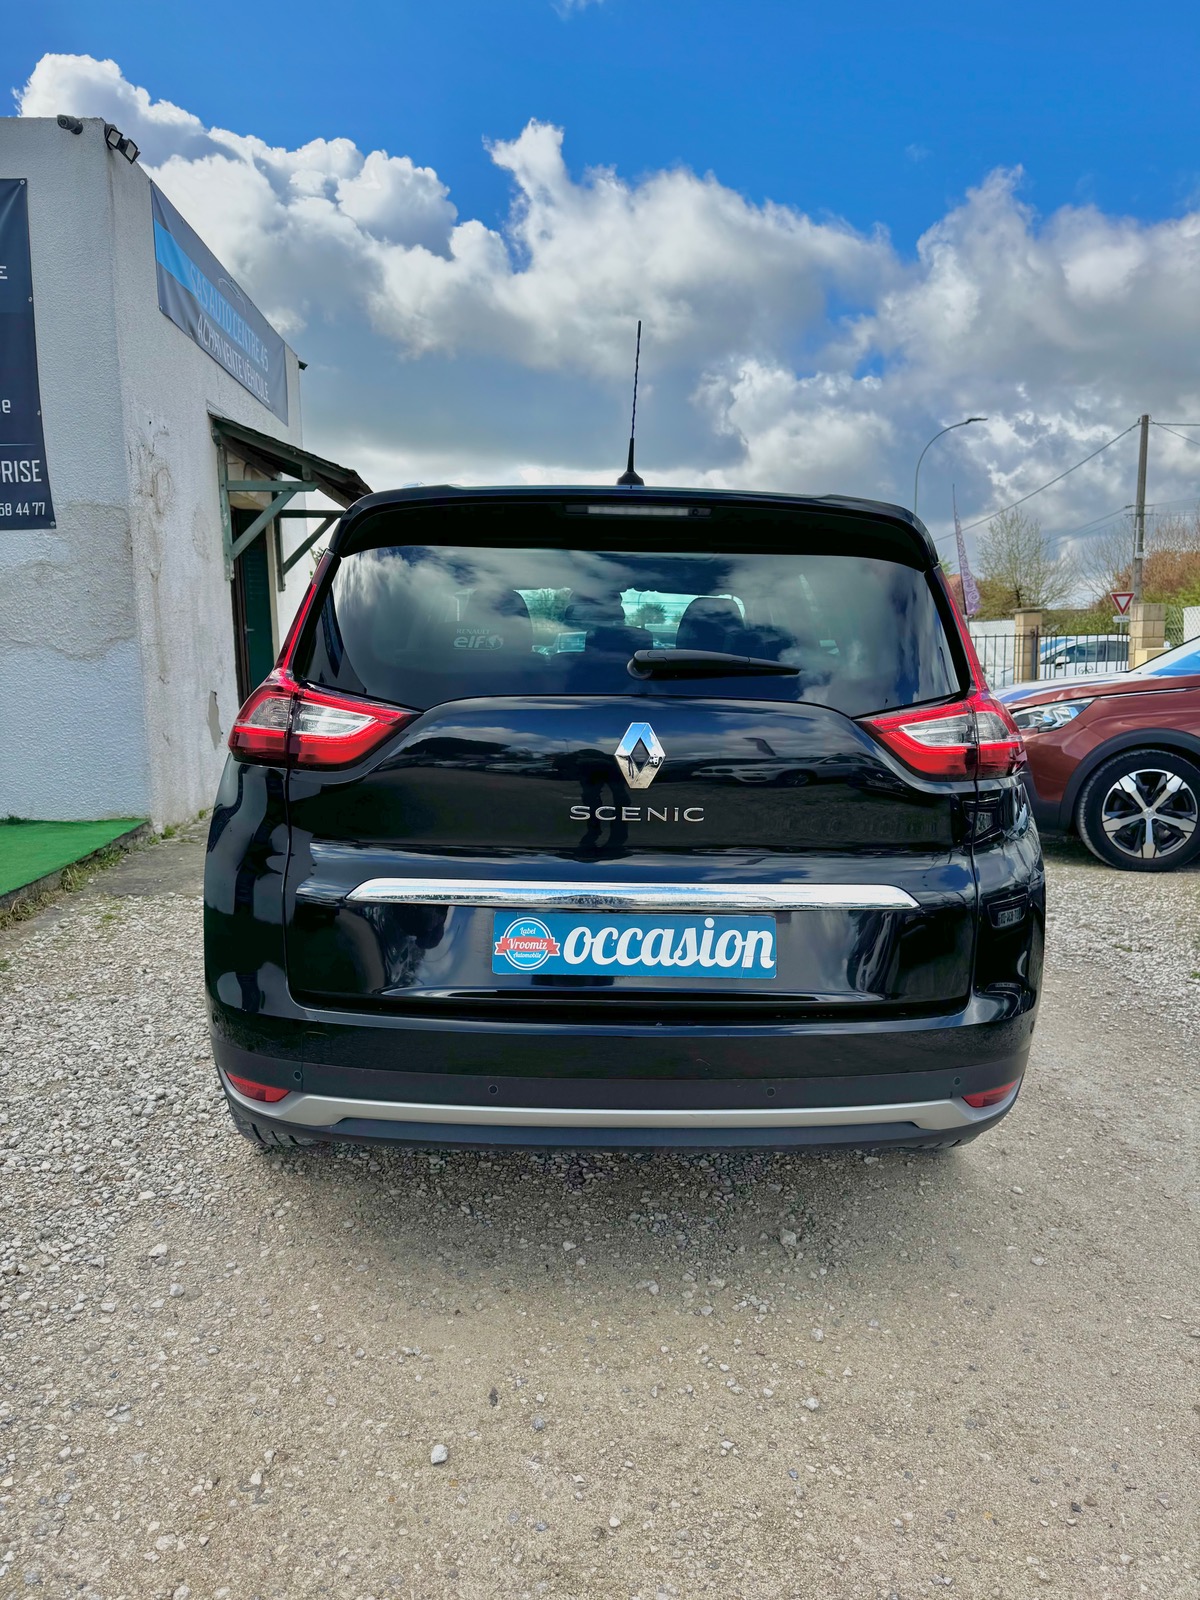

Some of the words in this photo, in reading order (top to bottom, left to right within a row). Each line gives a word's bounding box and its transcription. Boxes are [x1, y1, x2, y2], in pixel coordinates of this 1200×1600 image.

[209, 286, 232, 332] AUTO
[232, 312, 260, 363] CENTRE
[260, 344, 269, 373] 45
[15, 502, 30, 516] 44
[32, 502, 46, 515] 77
[520, 927, 537, 937] Label
[507, 938, 548, 950] Vroomiz
[563, 917, 776, 969] occasion
[513, 951, 542, 959] Automobile
